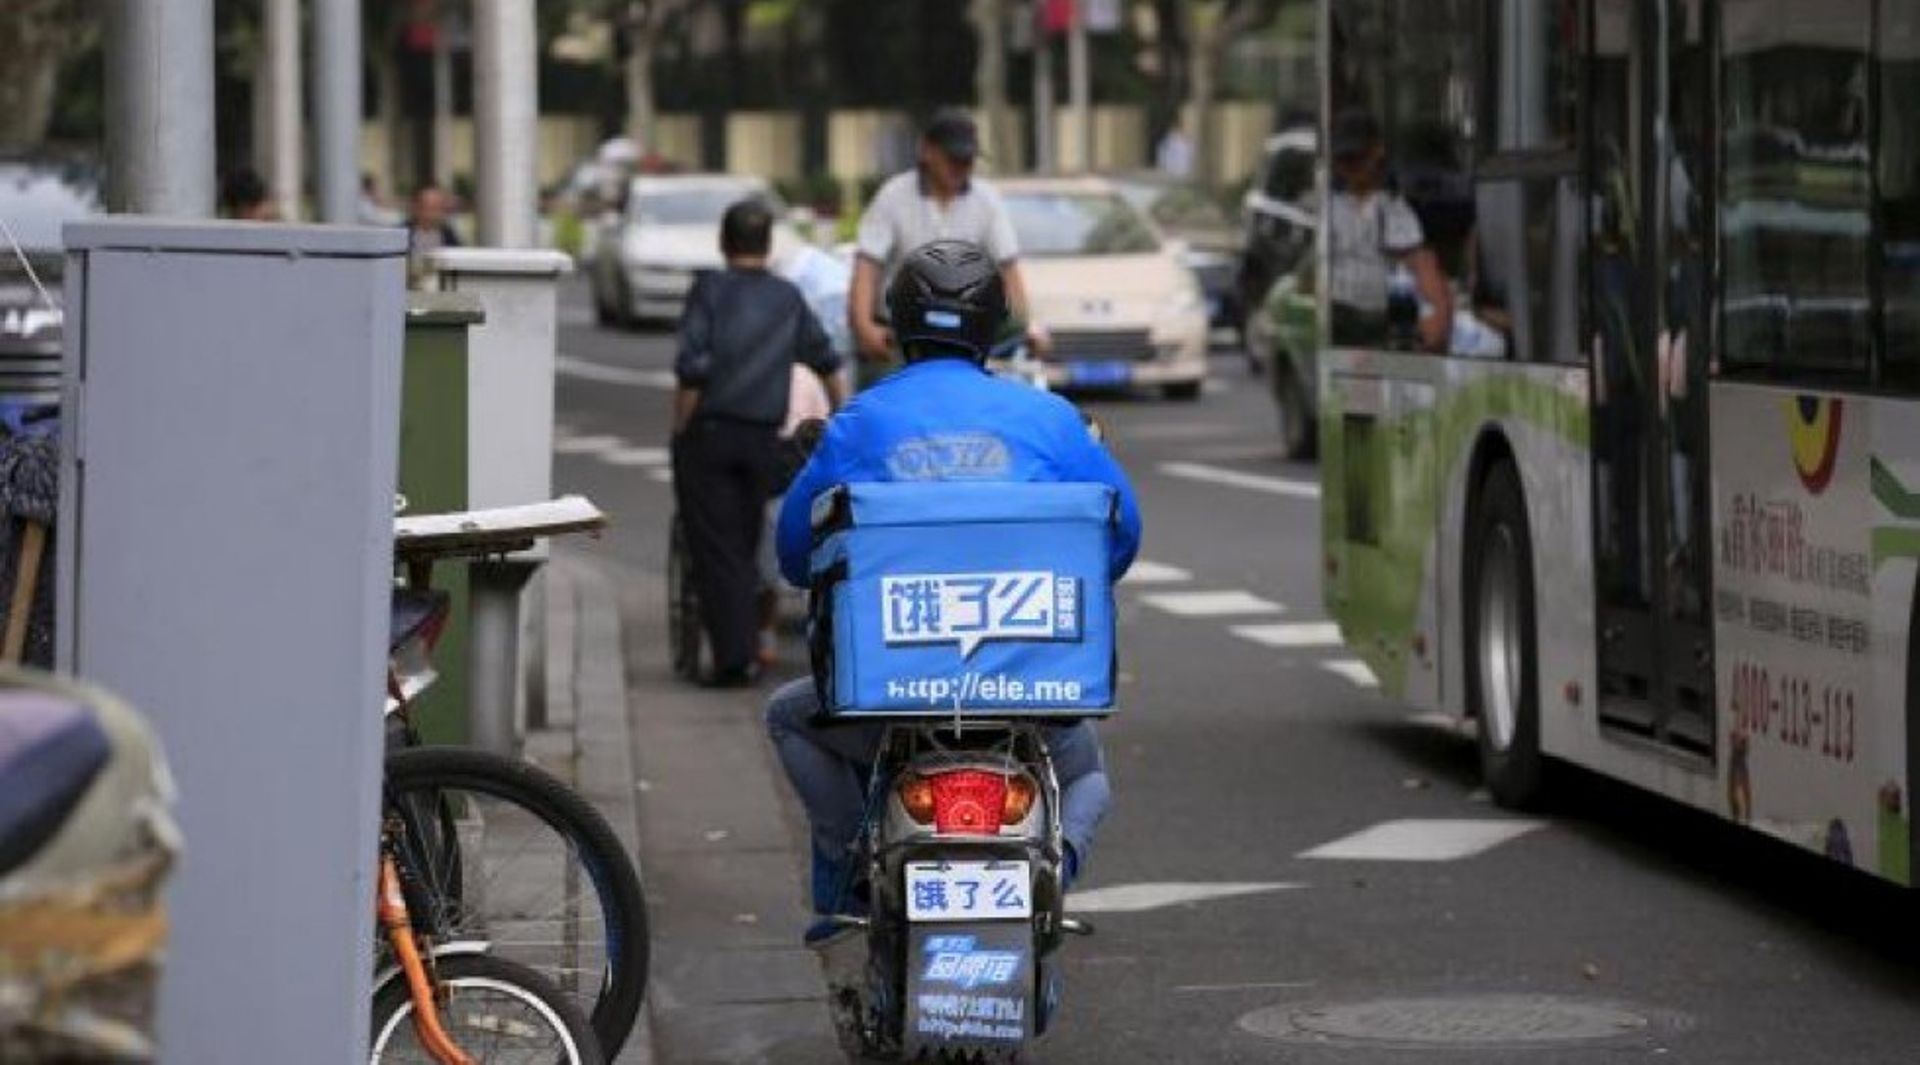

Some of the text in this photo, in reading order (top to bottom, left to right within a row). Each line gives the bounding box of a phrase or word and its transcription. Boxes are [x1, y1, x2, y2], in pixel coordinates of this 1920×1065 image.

[887, 576, 1048, 634] 饿了么
[914, 878, 1024, 911] 饿了么
